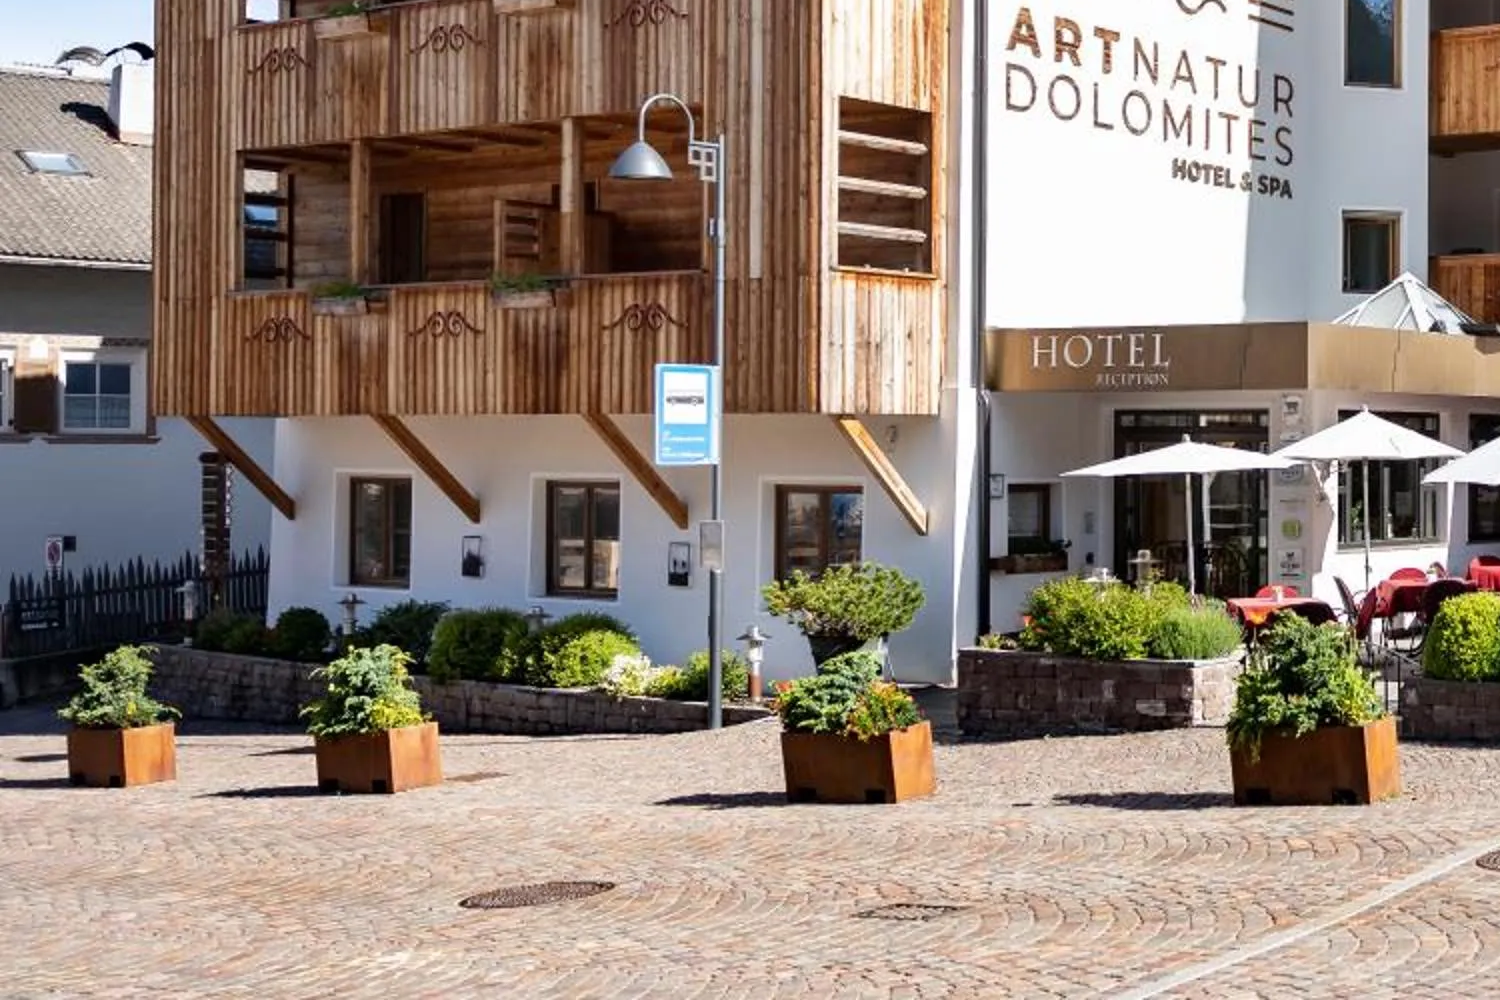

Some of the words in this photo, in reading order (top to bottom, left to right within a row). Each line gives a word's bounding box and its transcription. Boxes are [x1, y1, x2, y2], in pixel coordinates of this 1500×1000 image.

[1005, 62, 1294, 167] DOLOMITES
[1171, 157, 1236, 190] HOTEL
[1240, 171, 1253, 193] &
[1257, 174, 1293, 199] SPA
[1031, 333, 1171, 369] HOTEL
